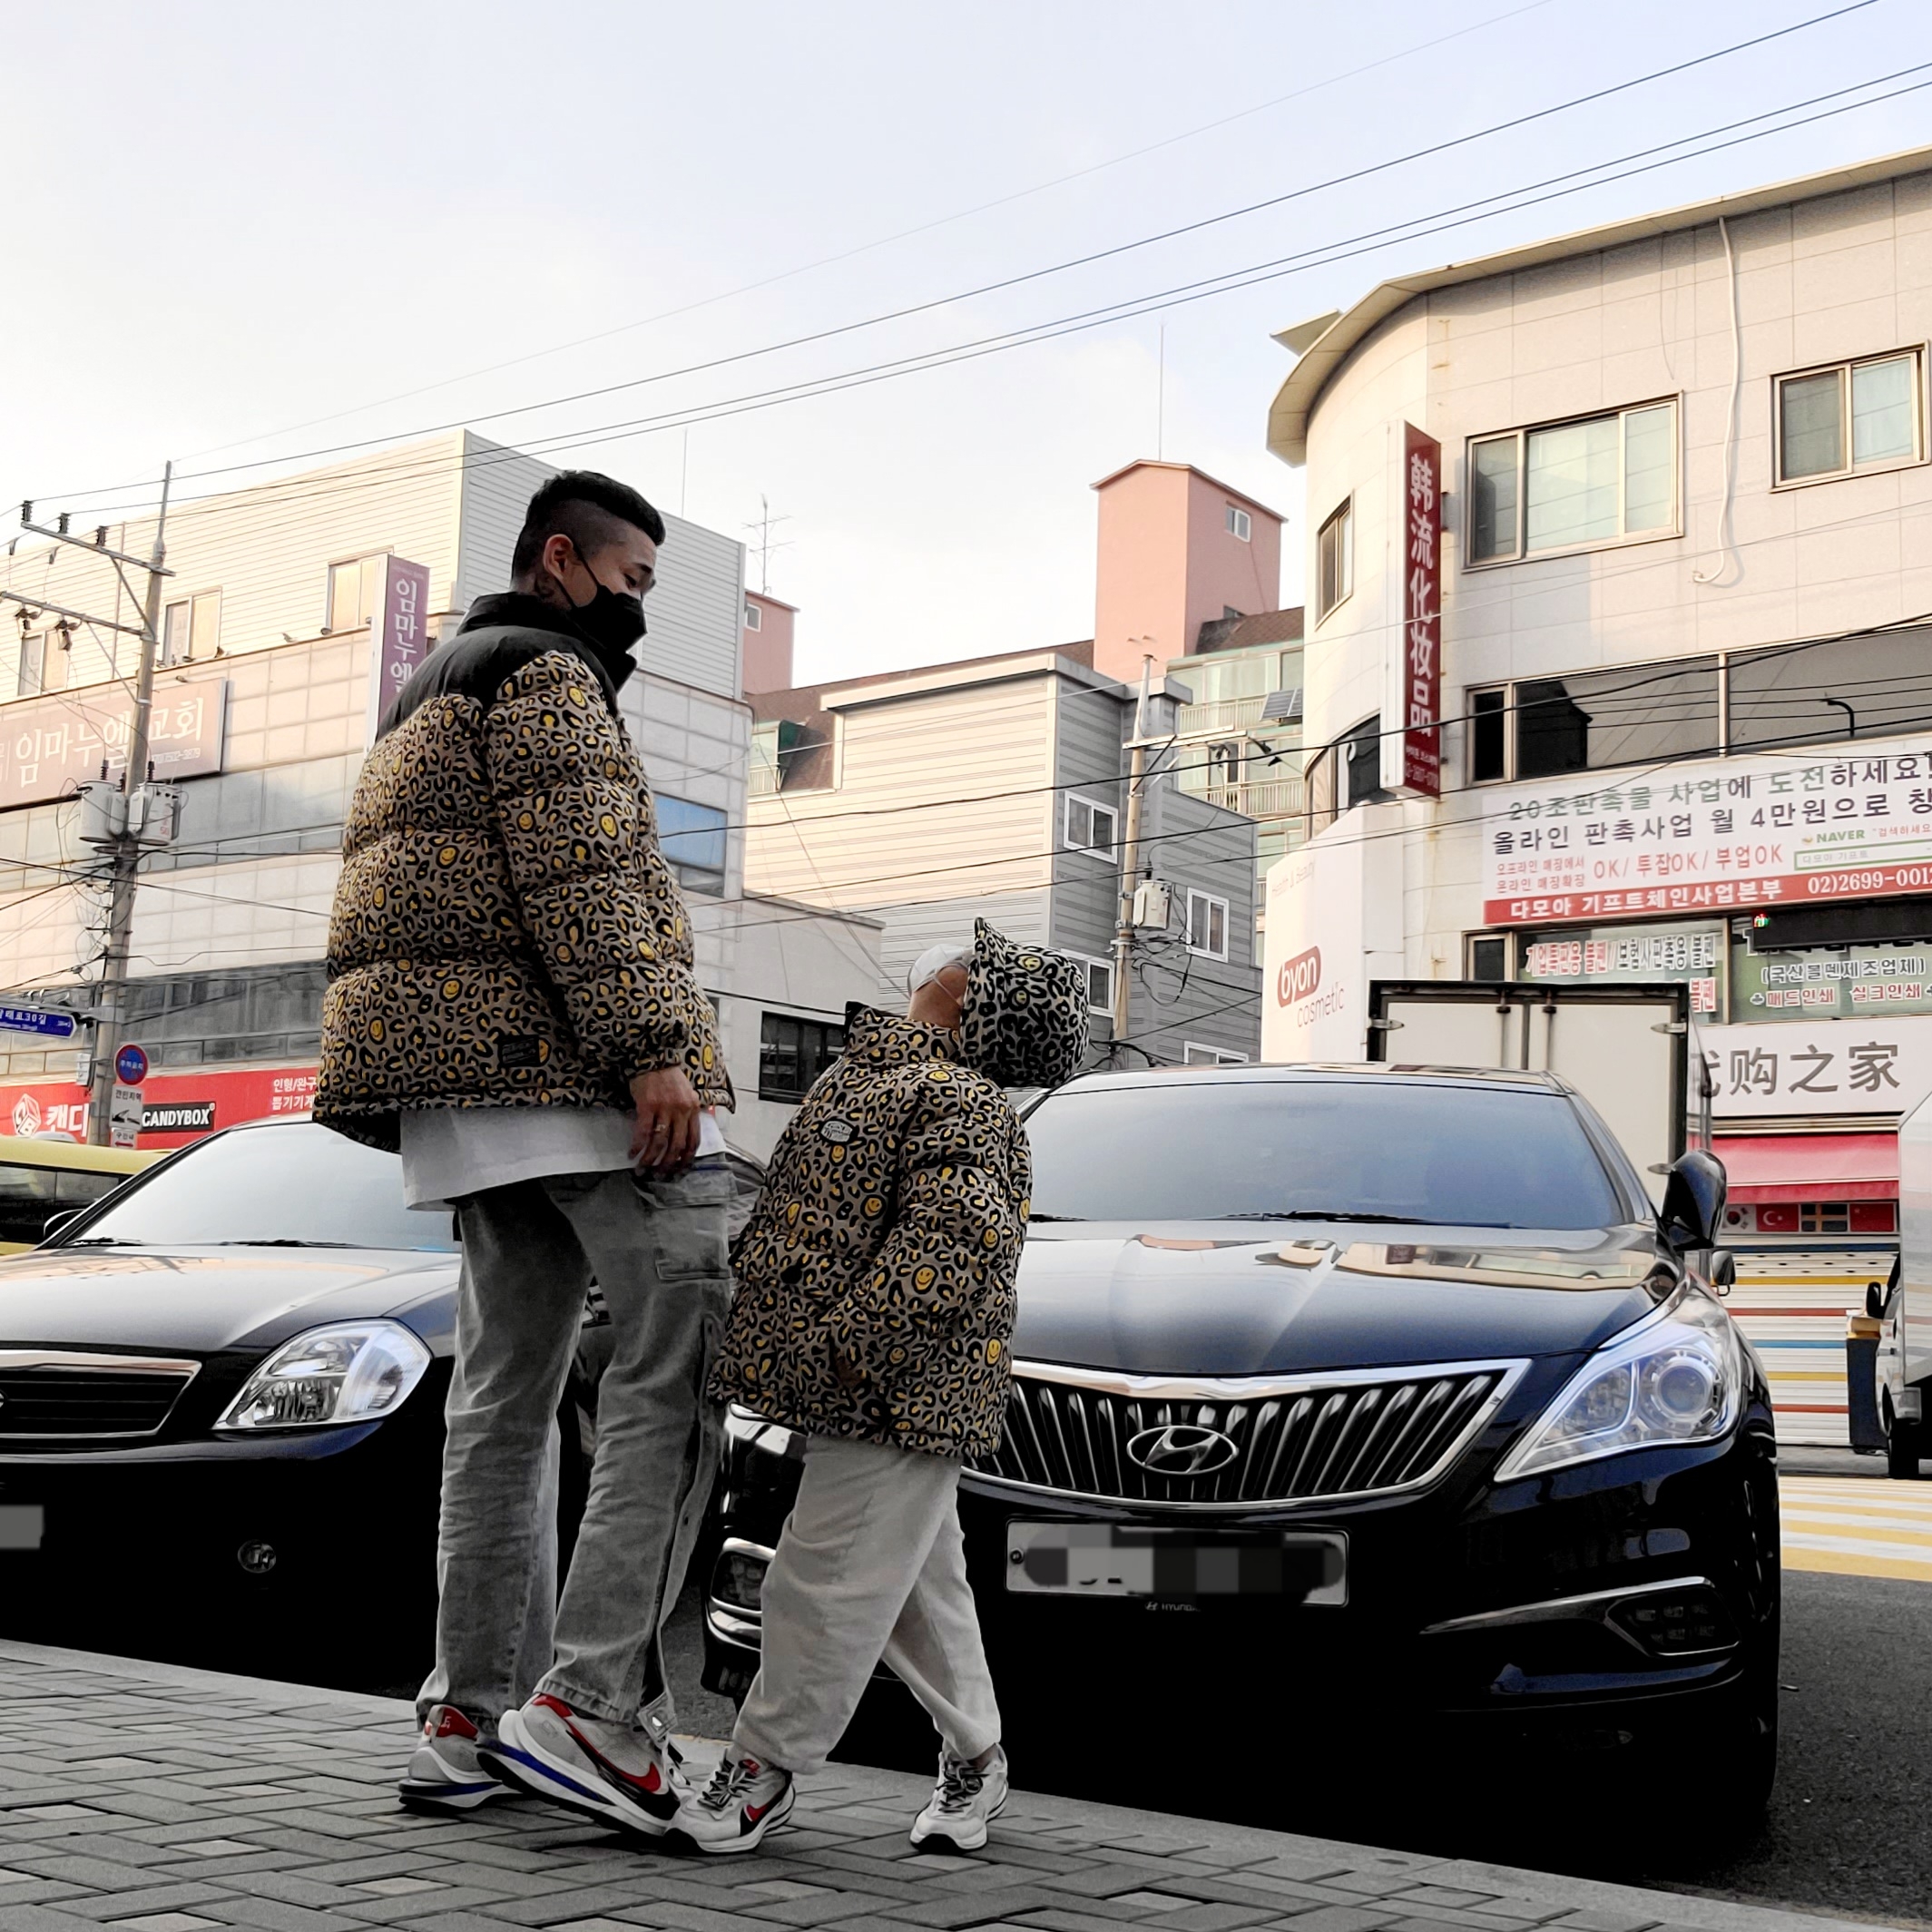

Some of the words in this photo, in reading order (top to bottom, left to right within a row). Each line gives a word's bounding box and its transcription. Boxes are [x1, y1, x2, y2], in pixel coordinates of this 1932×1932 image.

[16, 710, 132, 789] 임마누엘
[149, 696, 204, 742] 교회
[1667, 775, 1751, 806] 사업에
[1493, 824, 1570, 855] 올라인
[1584, 813, 1692, 846] 판촉사업
[1710, 808, 1734, 834] 월
[1750, 793, 1890, 829] 4만원으로
[1816, 829, 1866, 844] NAVER
[1496, 859, 1539, 877] 오프라인
[1542, 856, 1585, 873] 매장에서
[1594, 858, 1630, 879] OK/
[1715, 844, 1783, 871] 부업OK
[1496, 878, 1532, 895] 온라인
[1510, 897, 1572, 919] 다모아
[1582, 878, 1783, 914] 기프트체인사업본부
[1280, 953, 1319, 1004] byon
[1850, 983, 1922, 1004] 실크인쇄
[1297, 981, 1345, 1028] cosmetic
[273, 1075, 318, 1093] 인형/완구
[142, 1108, 210, 1128] CANDYBOX
